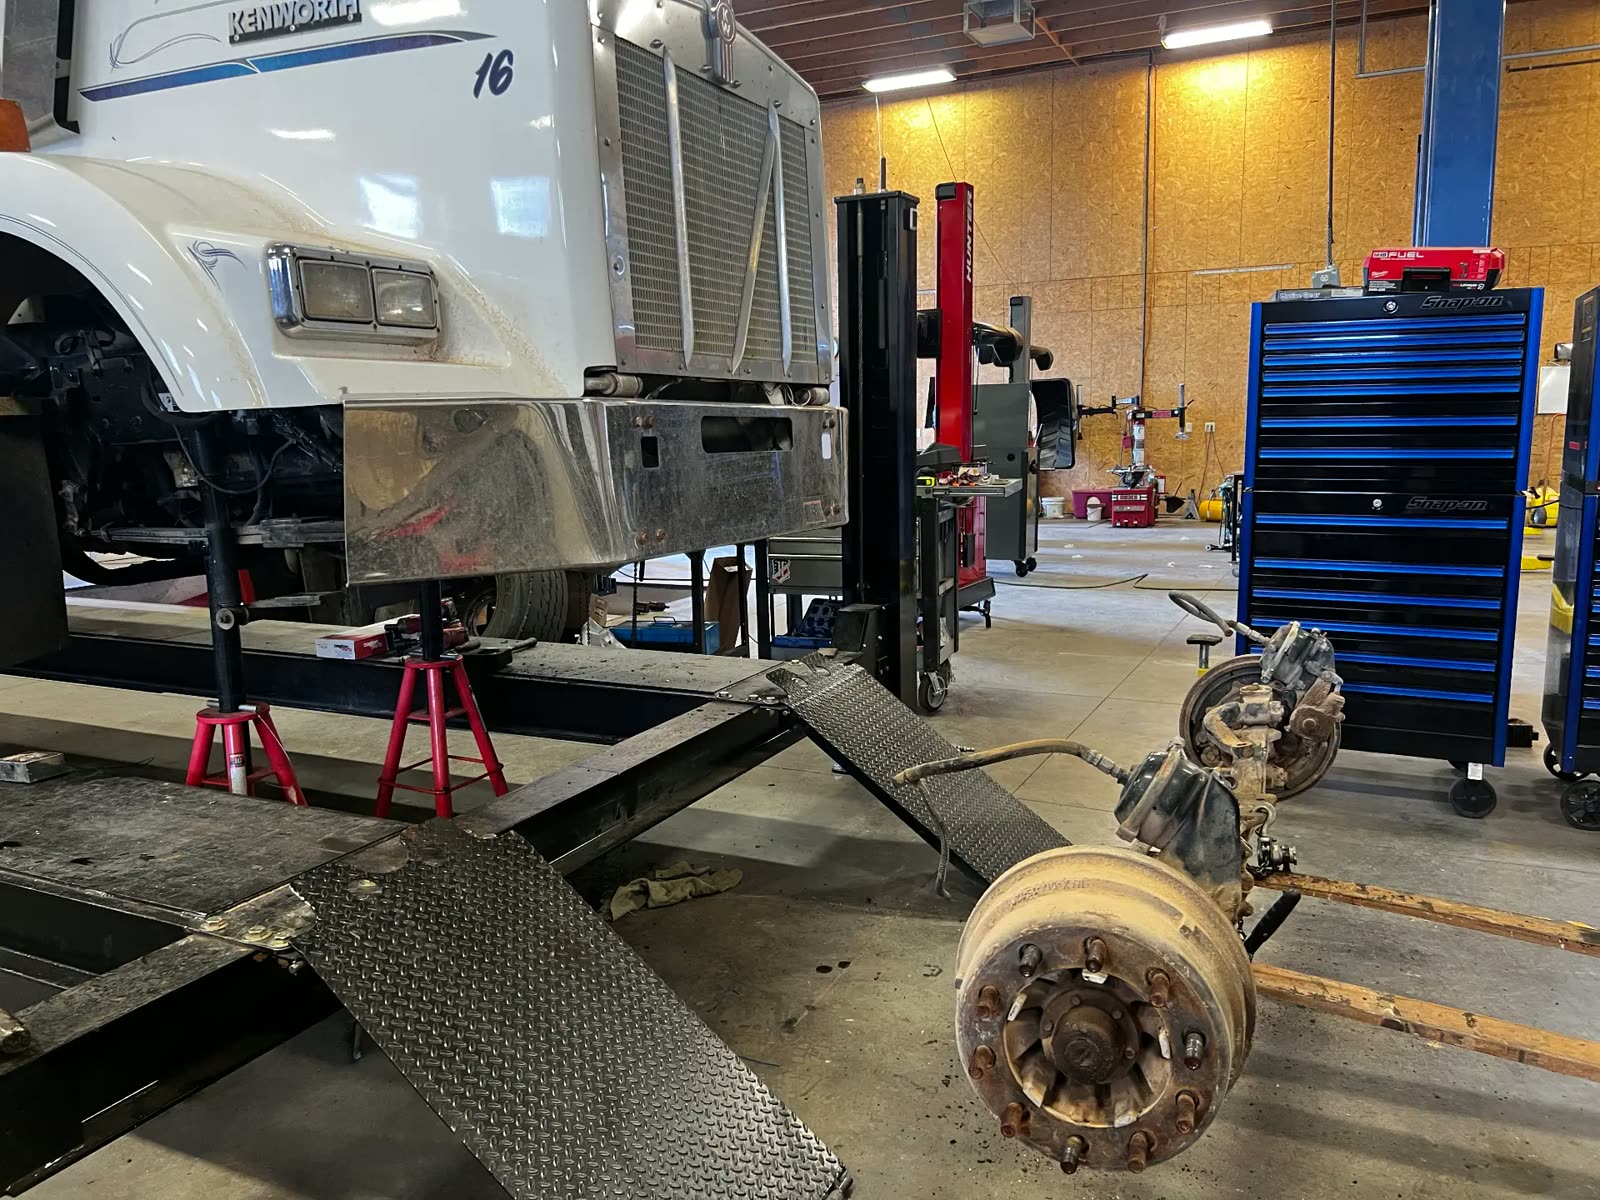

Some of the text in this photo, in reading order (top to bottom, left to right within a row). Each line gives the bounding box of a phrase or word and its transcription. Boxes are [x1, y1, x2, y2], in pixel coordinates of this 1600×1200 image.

[228, 0, 359, 35] KENWORTH
[473, 49, 514, 99] 16
[1420, 295, 1504, 311] Snap-on
[1405, 496, 1487, 513] Snap-on
